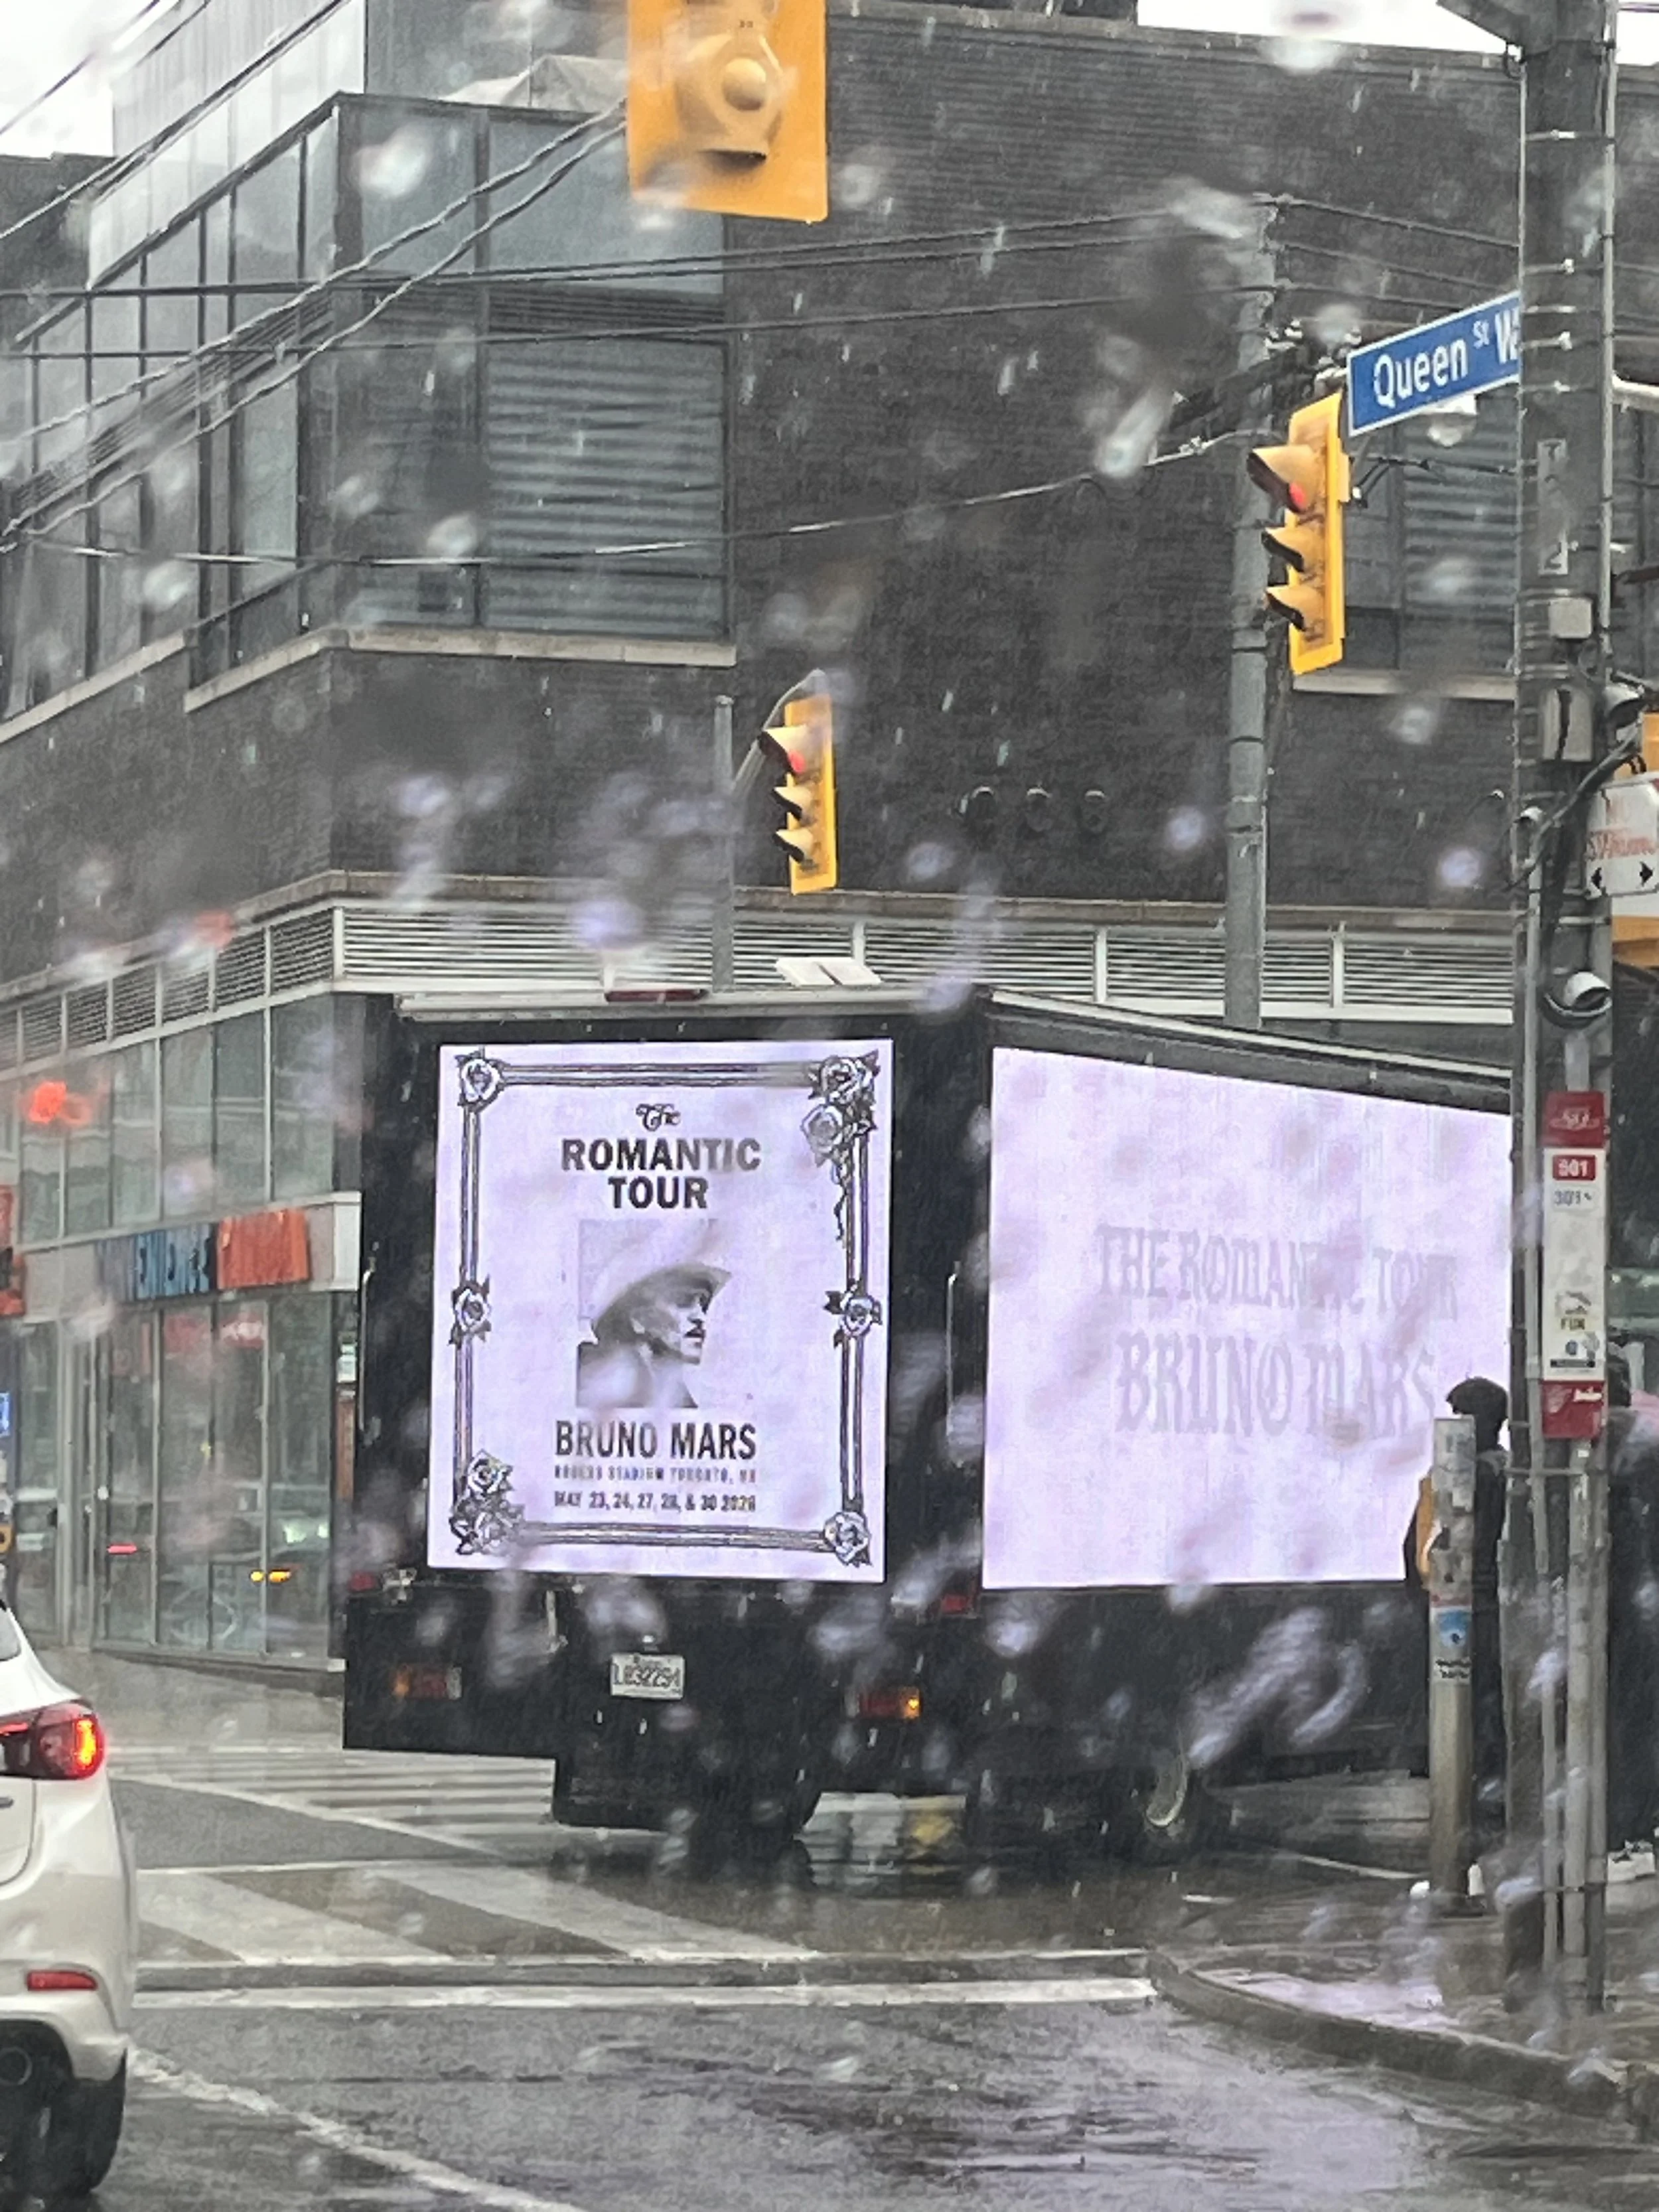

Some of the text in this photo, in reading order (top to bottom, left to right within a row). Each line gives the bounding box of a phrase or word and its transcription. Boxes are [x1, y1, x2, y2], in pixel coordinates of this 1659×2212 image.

[1373, 307, 1520, 407] Queen St W
[636, 1103, 681, 1132] The
[561, 1138, 761, 1171] ROMANTIC
[1558, 1159, 1588, 1177] 501
[608, 1175, 709, 1209] TOUR
[1095, 1224, 1169, 1299] THE
[1116, 1329, 1435, 1439] BRUNO MARS
[555, 1420, 757, 1460] BRUNO MARS
[555, 1491, 583, 1508] MAY
